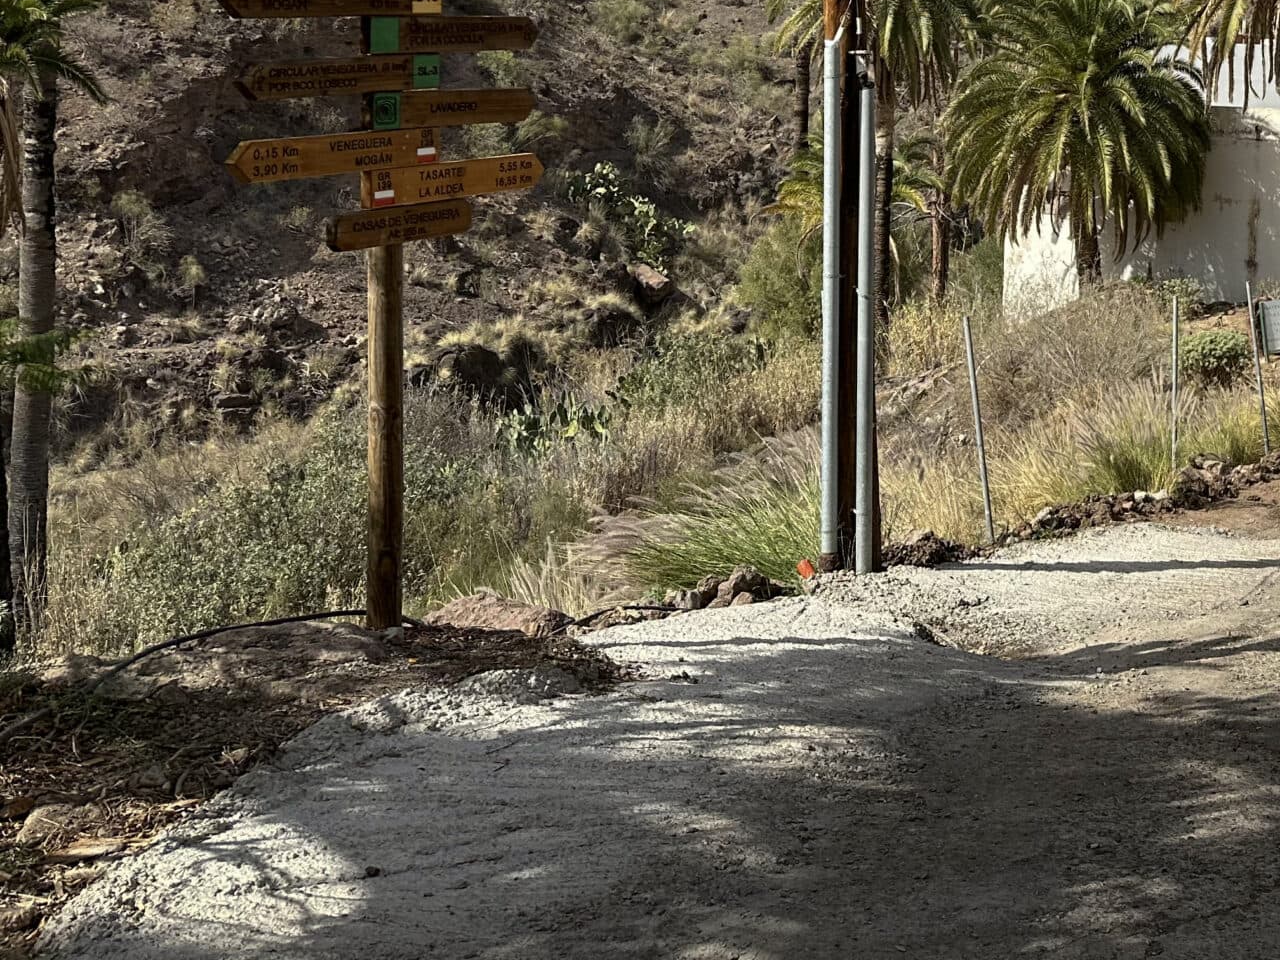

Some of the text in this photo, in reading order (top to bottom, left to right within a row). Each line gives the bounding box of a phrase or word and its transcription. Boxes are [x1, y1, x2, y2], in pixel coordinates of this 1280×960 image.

[282, 147, 299, 158] Km
[329, 137, 393, 153] VENEGUERA
[355, 152, 393, 167] MOGÁN
[282, 163, 298, 174] Km
[377, 171, 391, 181] GR
[418, 167, 464, 181] TASARTE
[520, 159, 533, 170] Km
[418, 187, 431, 198] LA
[434, 183, 465, 196] ALDEA
[520, 174, 533, 184] Km
[352, 208, 460, 232] CASAS DE VENEGUERA
